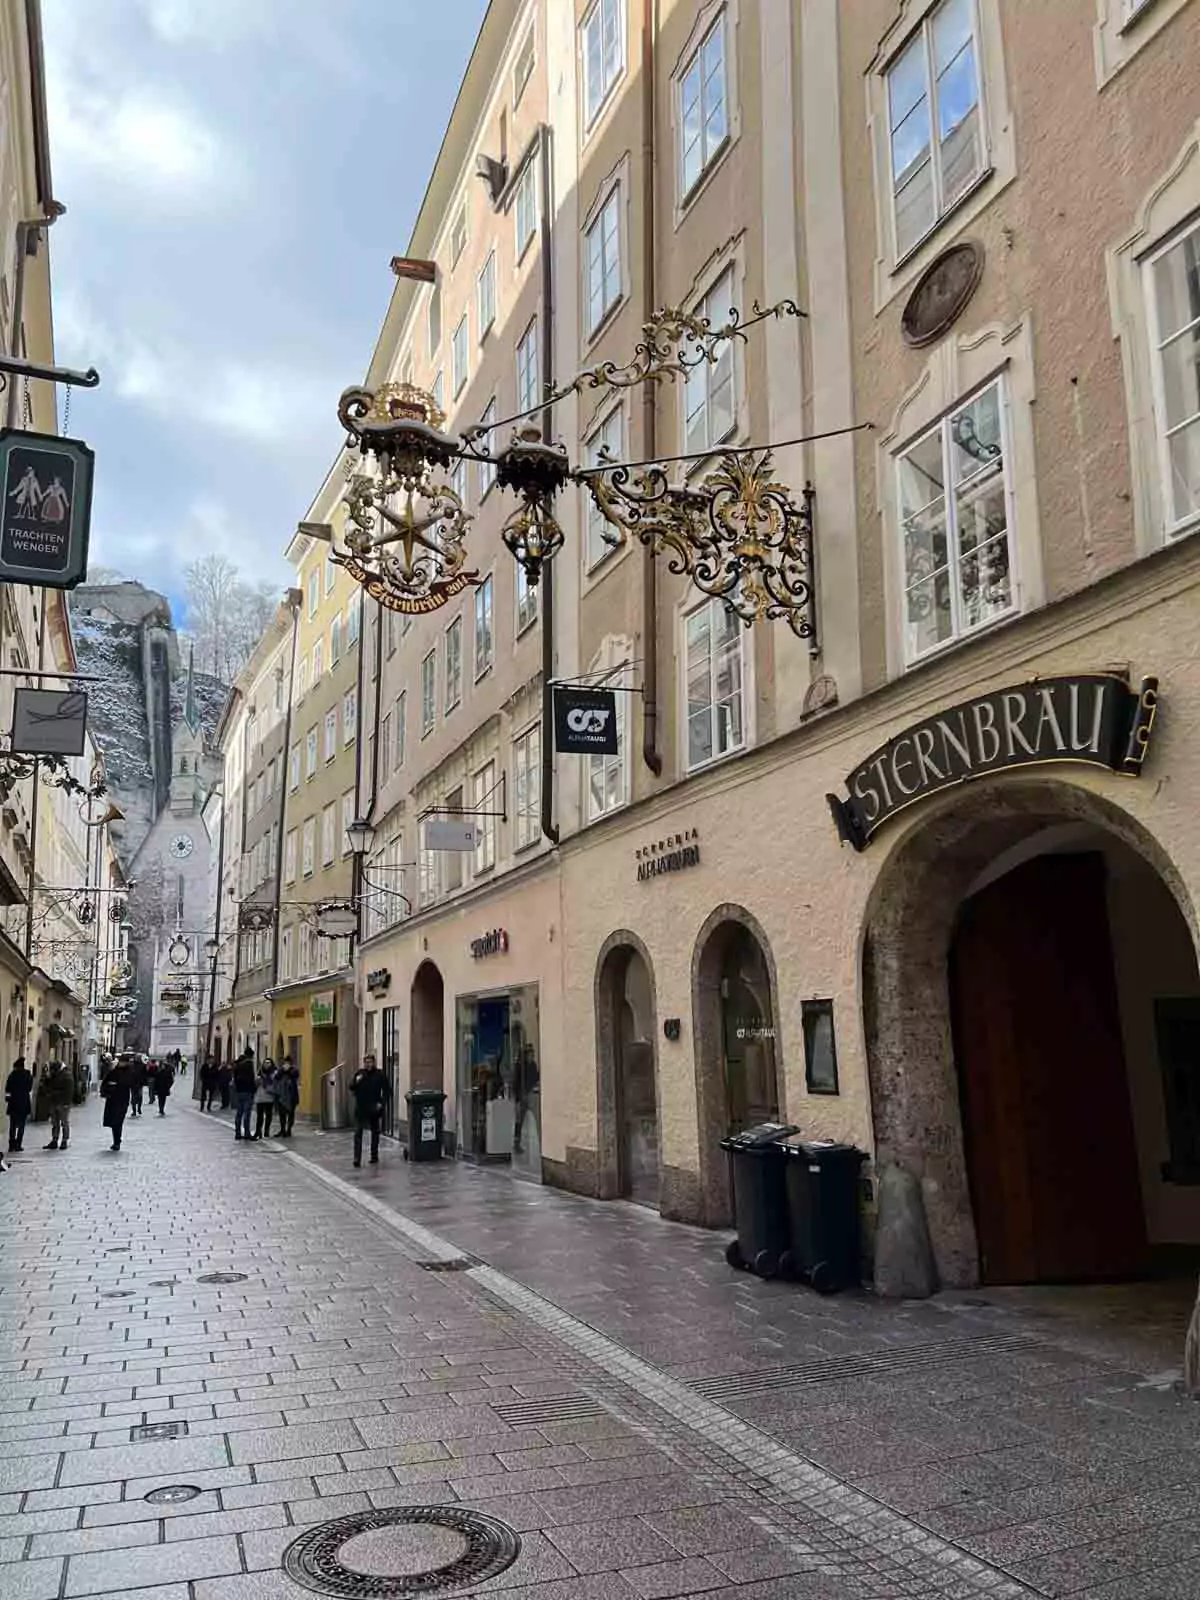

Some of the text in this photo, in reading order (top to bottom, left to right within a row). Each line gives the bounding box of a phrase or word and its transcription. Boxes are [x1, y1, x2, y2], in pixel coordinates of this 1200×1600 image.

[8, 528, 65, 544] TRACHTEN
[13, 540, 59, 554] WENGER
[853, 683, 1105, 822] STERNBRÄU
